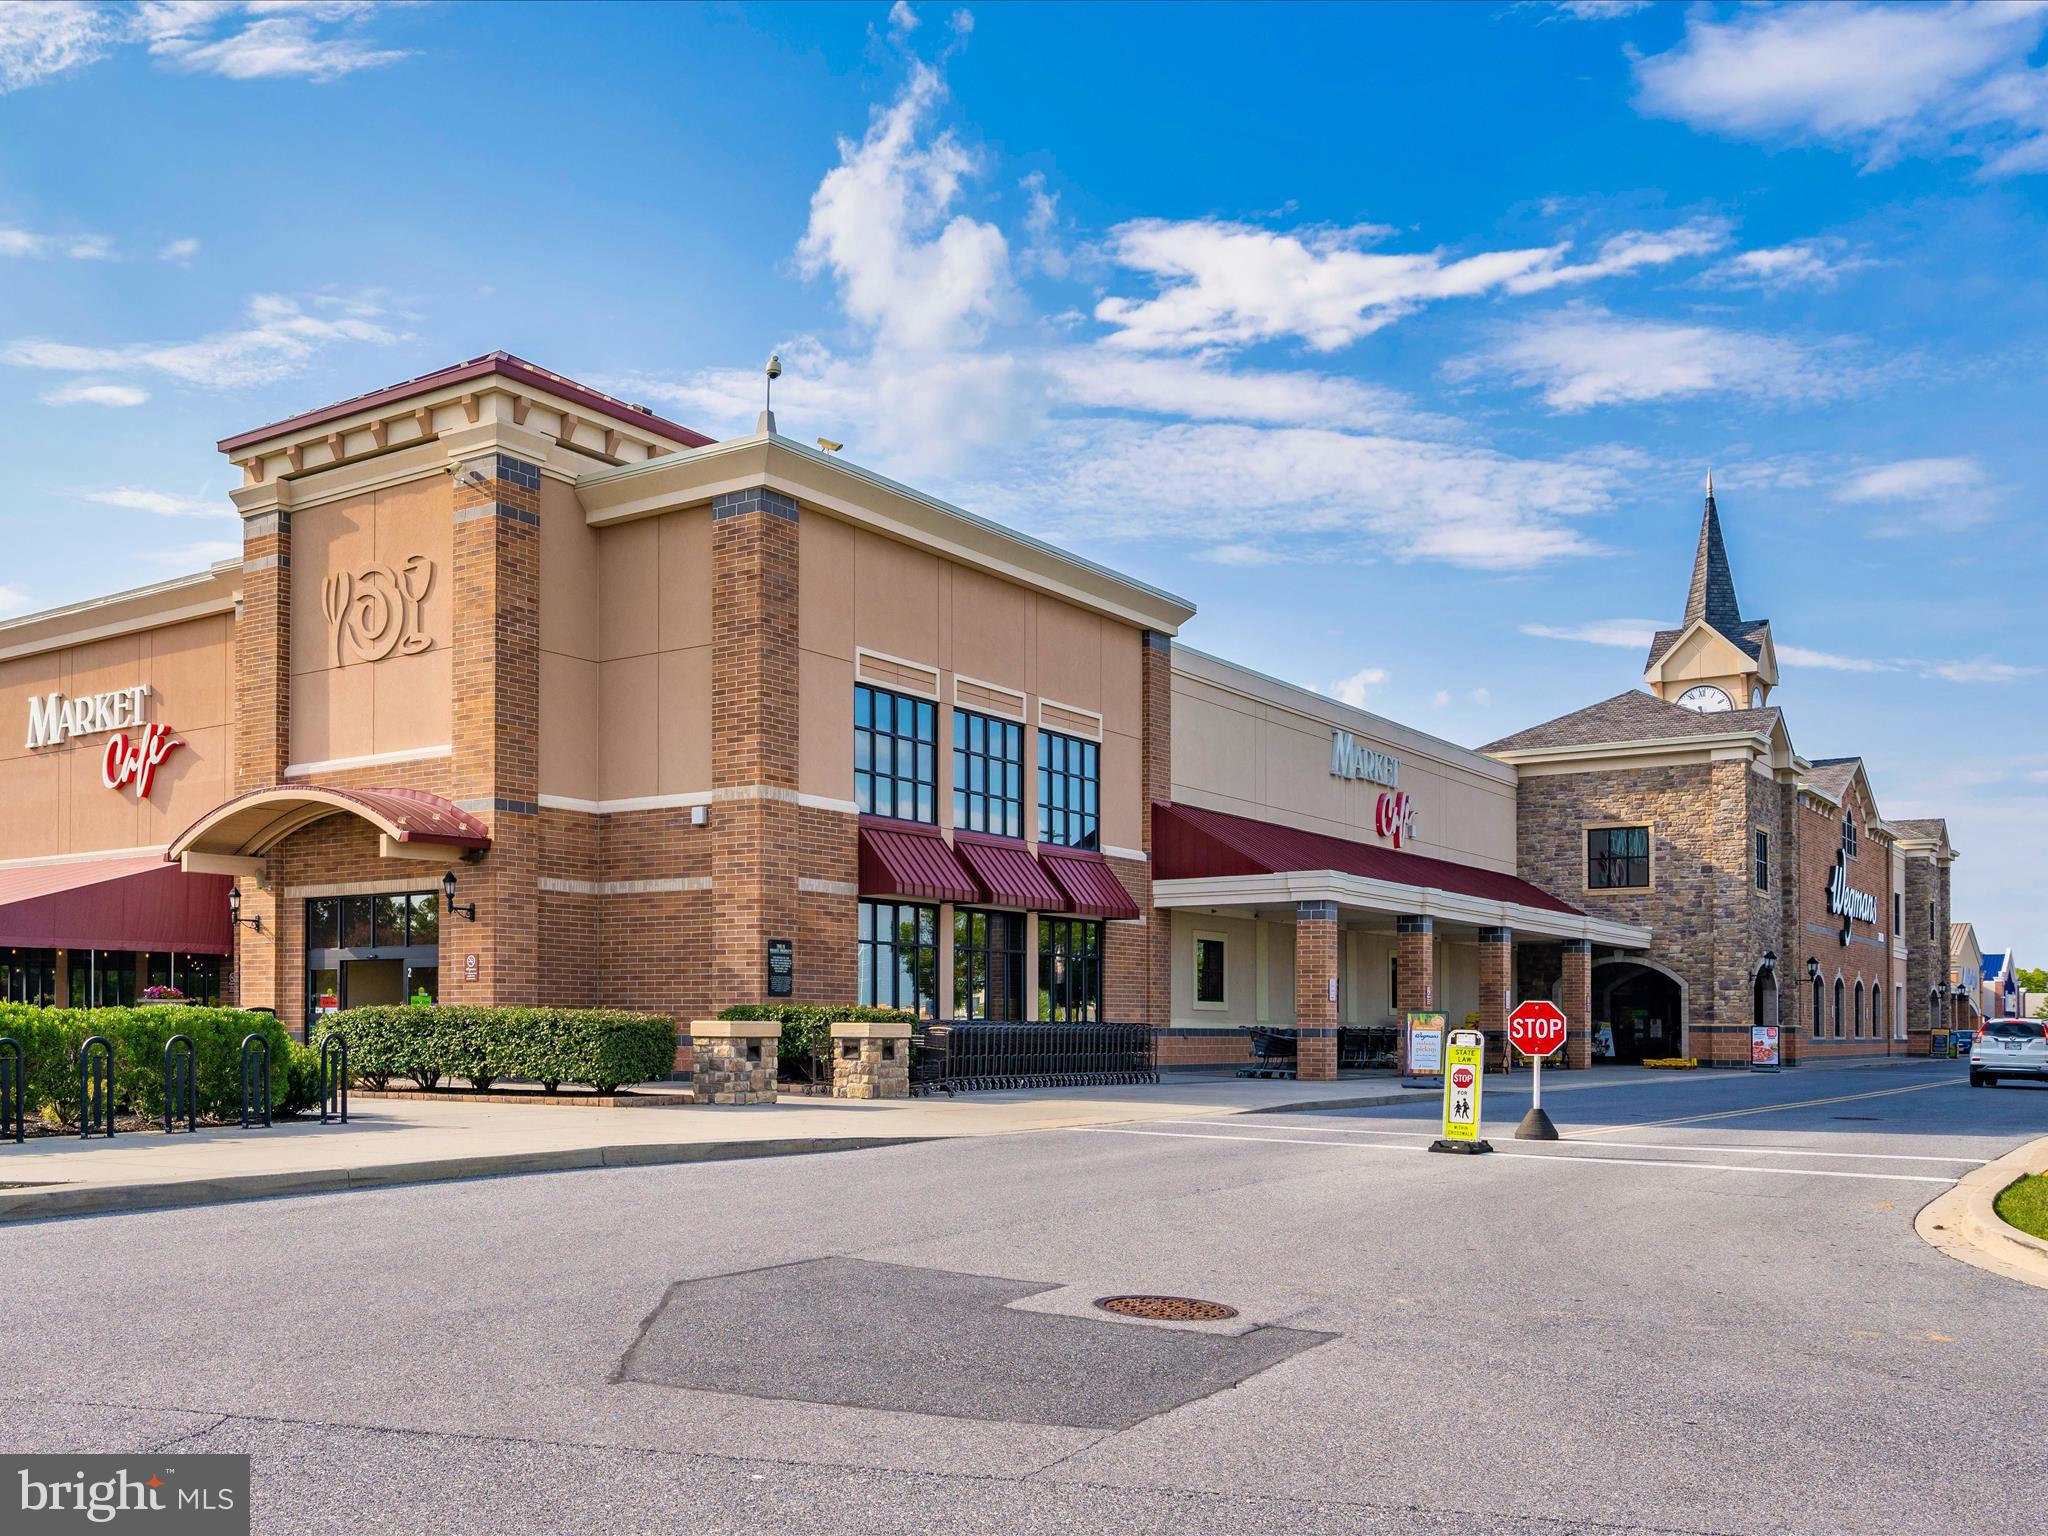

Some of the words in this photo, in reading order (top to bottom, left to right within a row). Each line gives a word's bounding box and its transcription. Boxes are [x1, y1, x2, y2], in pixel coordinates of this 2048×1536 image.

[25, 684, 152, 749] MARKET
[101, 722, 186, 798] Café
[1329, 729, 1401, 789] MARKET
[1825, 848, 1878, 947] Wegmans
[407, 968, 412, 978] 2
[1512, 1018, 1563, 1039] STOP
[1453, 1074, 1473, 1083] STOP
